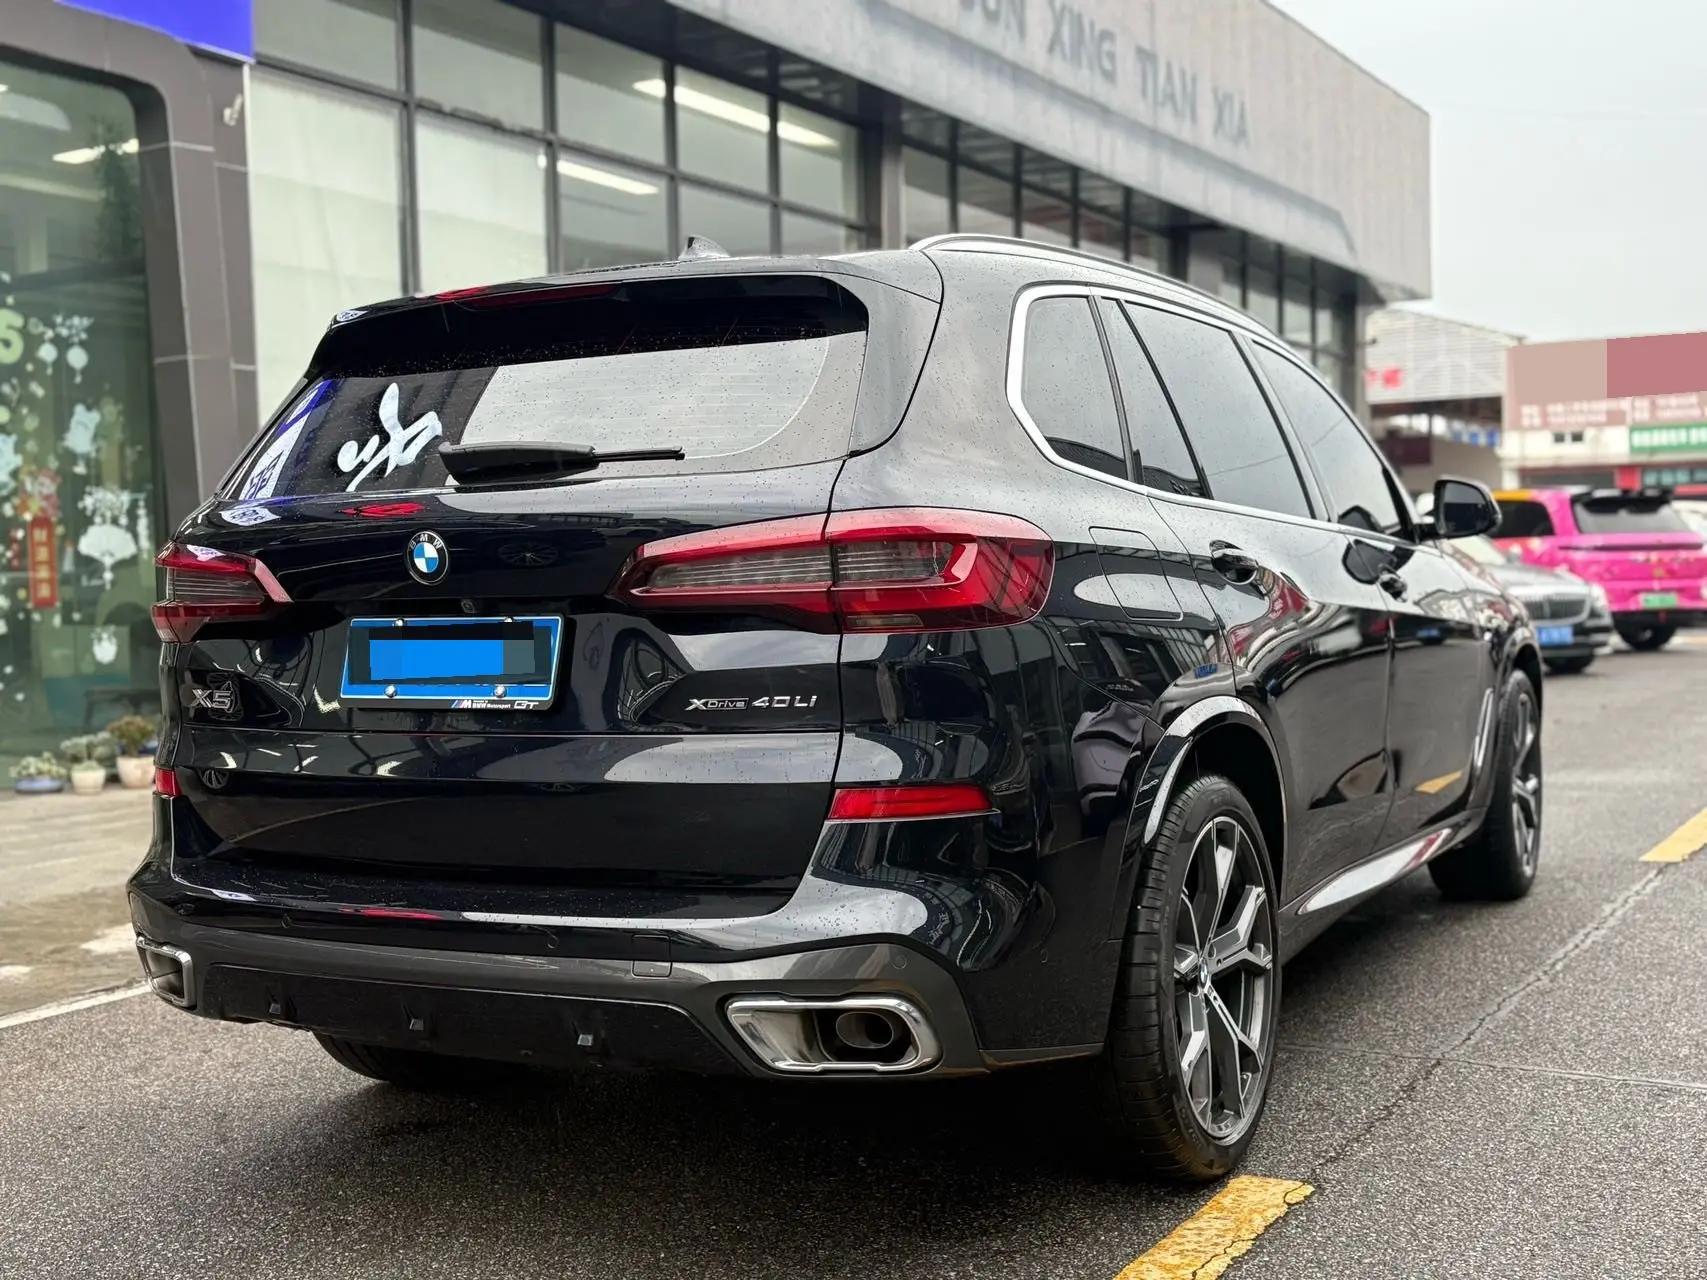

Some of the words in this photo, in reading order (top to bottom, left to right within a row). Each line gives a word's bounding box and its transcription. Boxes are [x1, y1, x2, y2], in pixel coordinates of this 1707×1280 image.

[1047, 0, 1117, 83] XING
[1134, 45, 1197, 124] TIAN
[1212, 85, 1250, 147] XIA
[409, 533, 443, 549] BMW
[191, 688, 231, 709] X5
